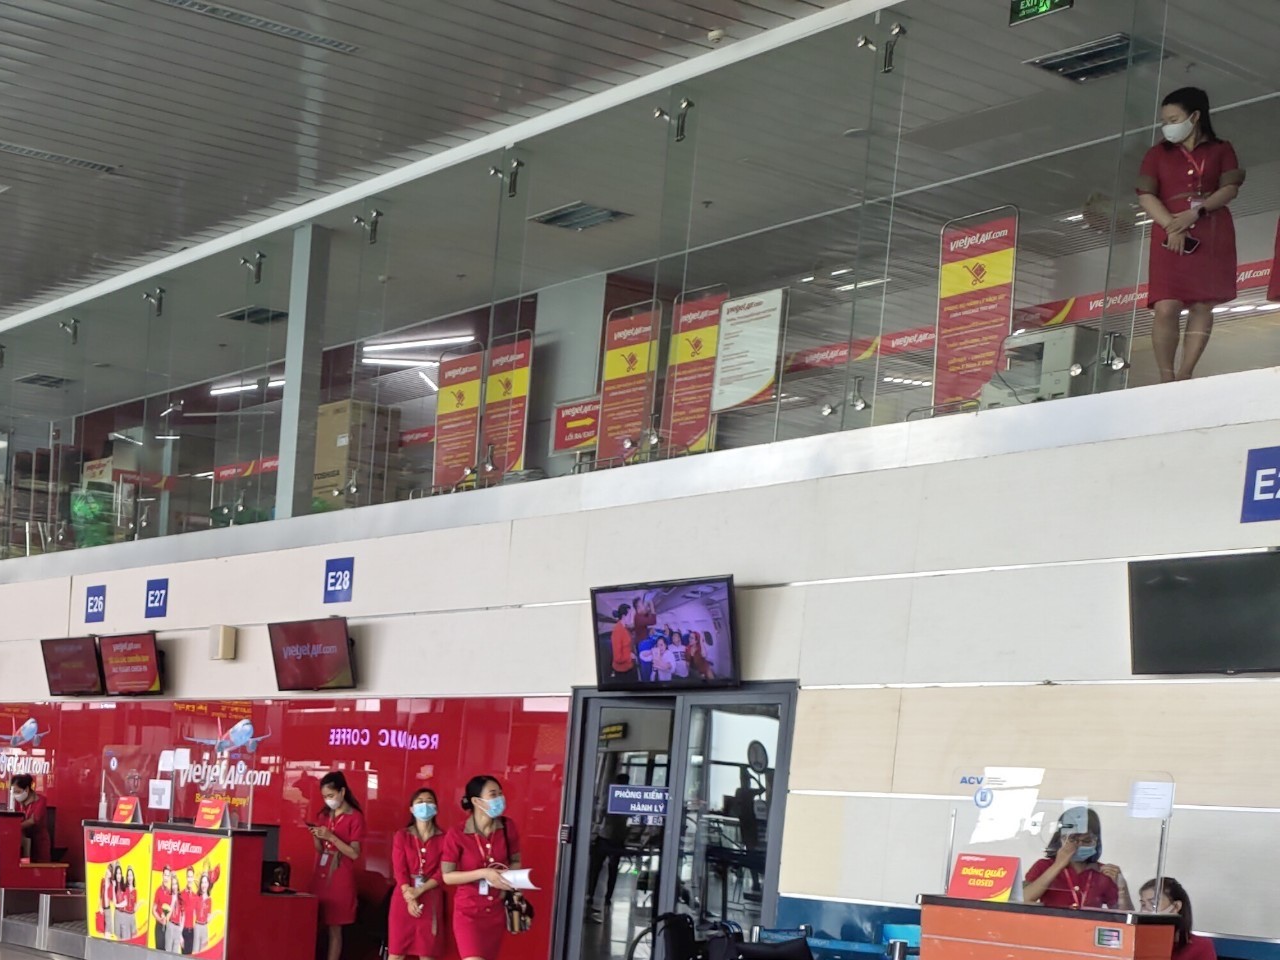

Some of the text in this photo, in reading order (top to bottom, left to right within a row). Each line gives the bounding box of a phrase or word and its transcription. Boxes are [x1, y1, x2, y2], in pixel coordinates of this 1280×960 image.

[1253, 467, 1280, 500] E
[327, 571, 350, 591] E28
[87, 596, 103, 613] E26
[147, 590, 166, 608] E27
[960, 776, 983, 785] ACV
